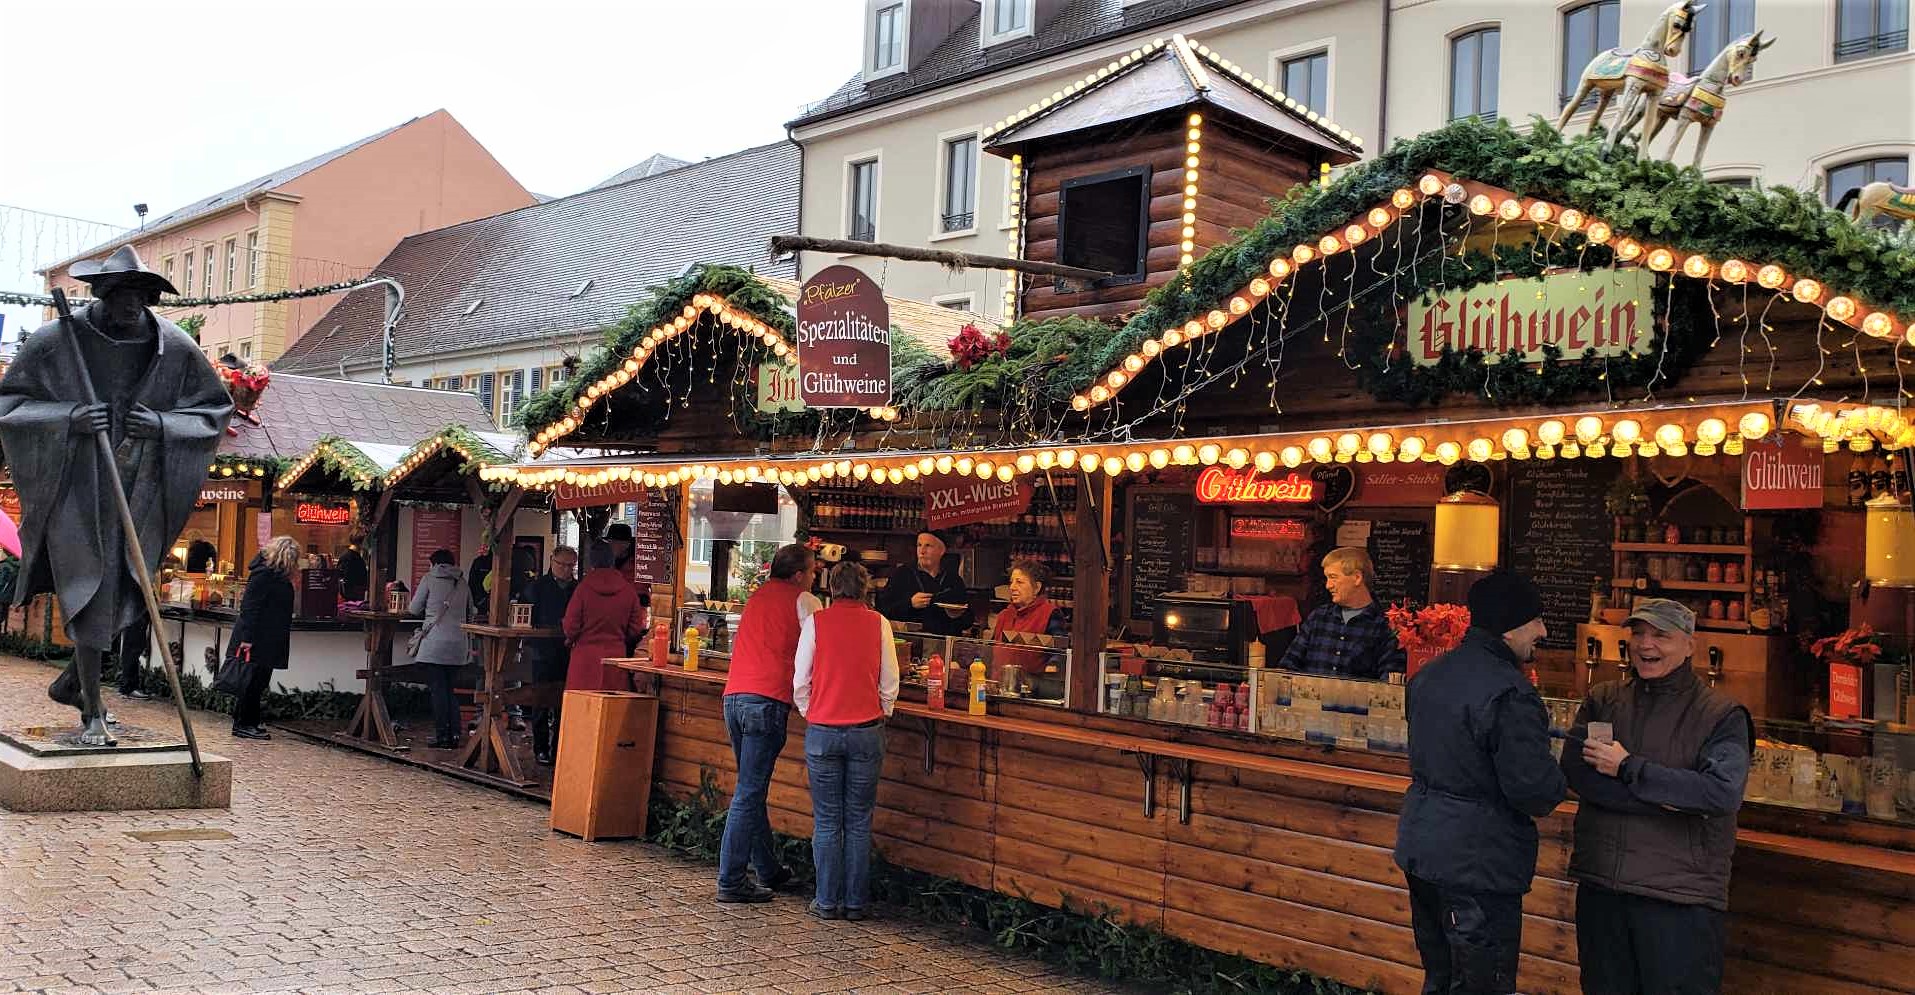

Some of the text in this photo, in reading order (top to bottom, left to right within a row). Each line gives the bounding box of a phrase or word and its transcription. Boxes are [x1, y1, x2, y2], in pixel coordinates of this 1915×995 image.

[799, 310, 890, 348] Spezialitäten
[1420, 284, 1640, 360] Glühwein
[832, 353, 858, 365] und
[803, 372, 887, 395] Glühweine
[1197, 465, 1313, 501] Gühwein
[1747, 450, 1821, 490] Glühwein
[299, 503, 350, 521] Glühwein
[930, 480, 1019, 511] XXL-Wurst
